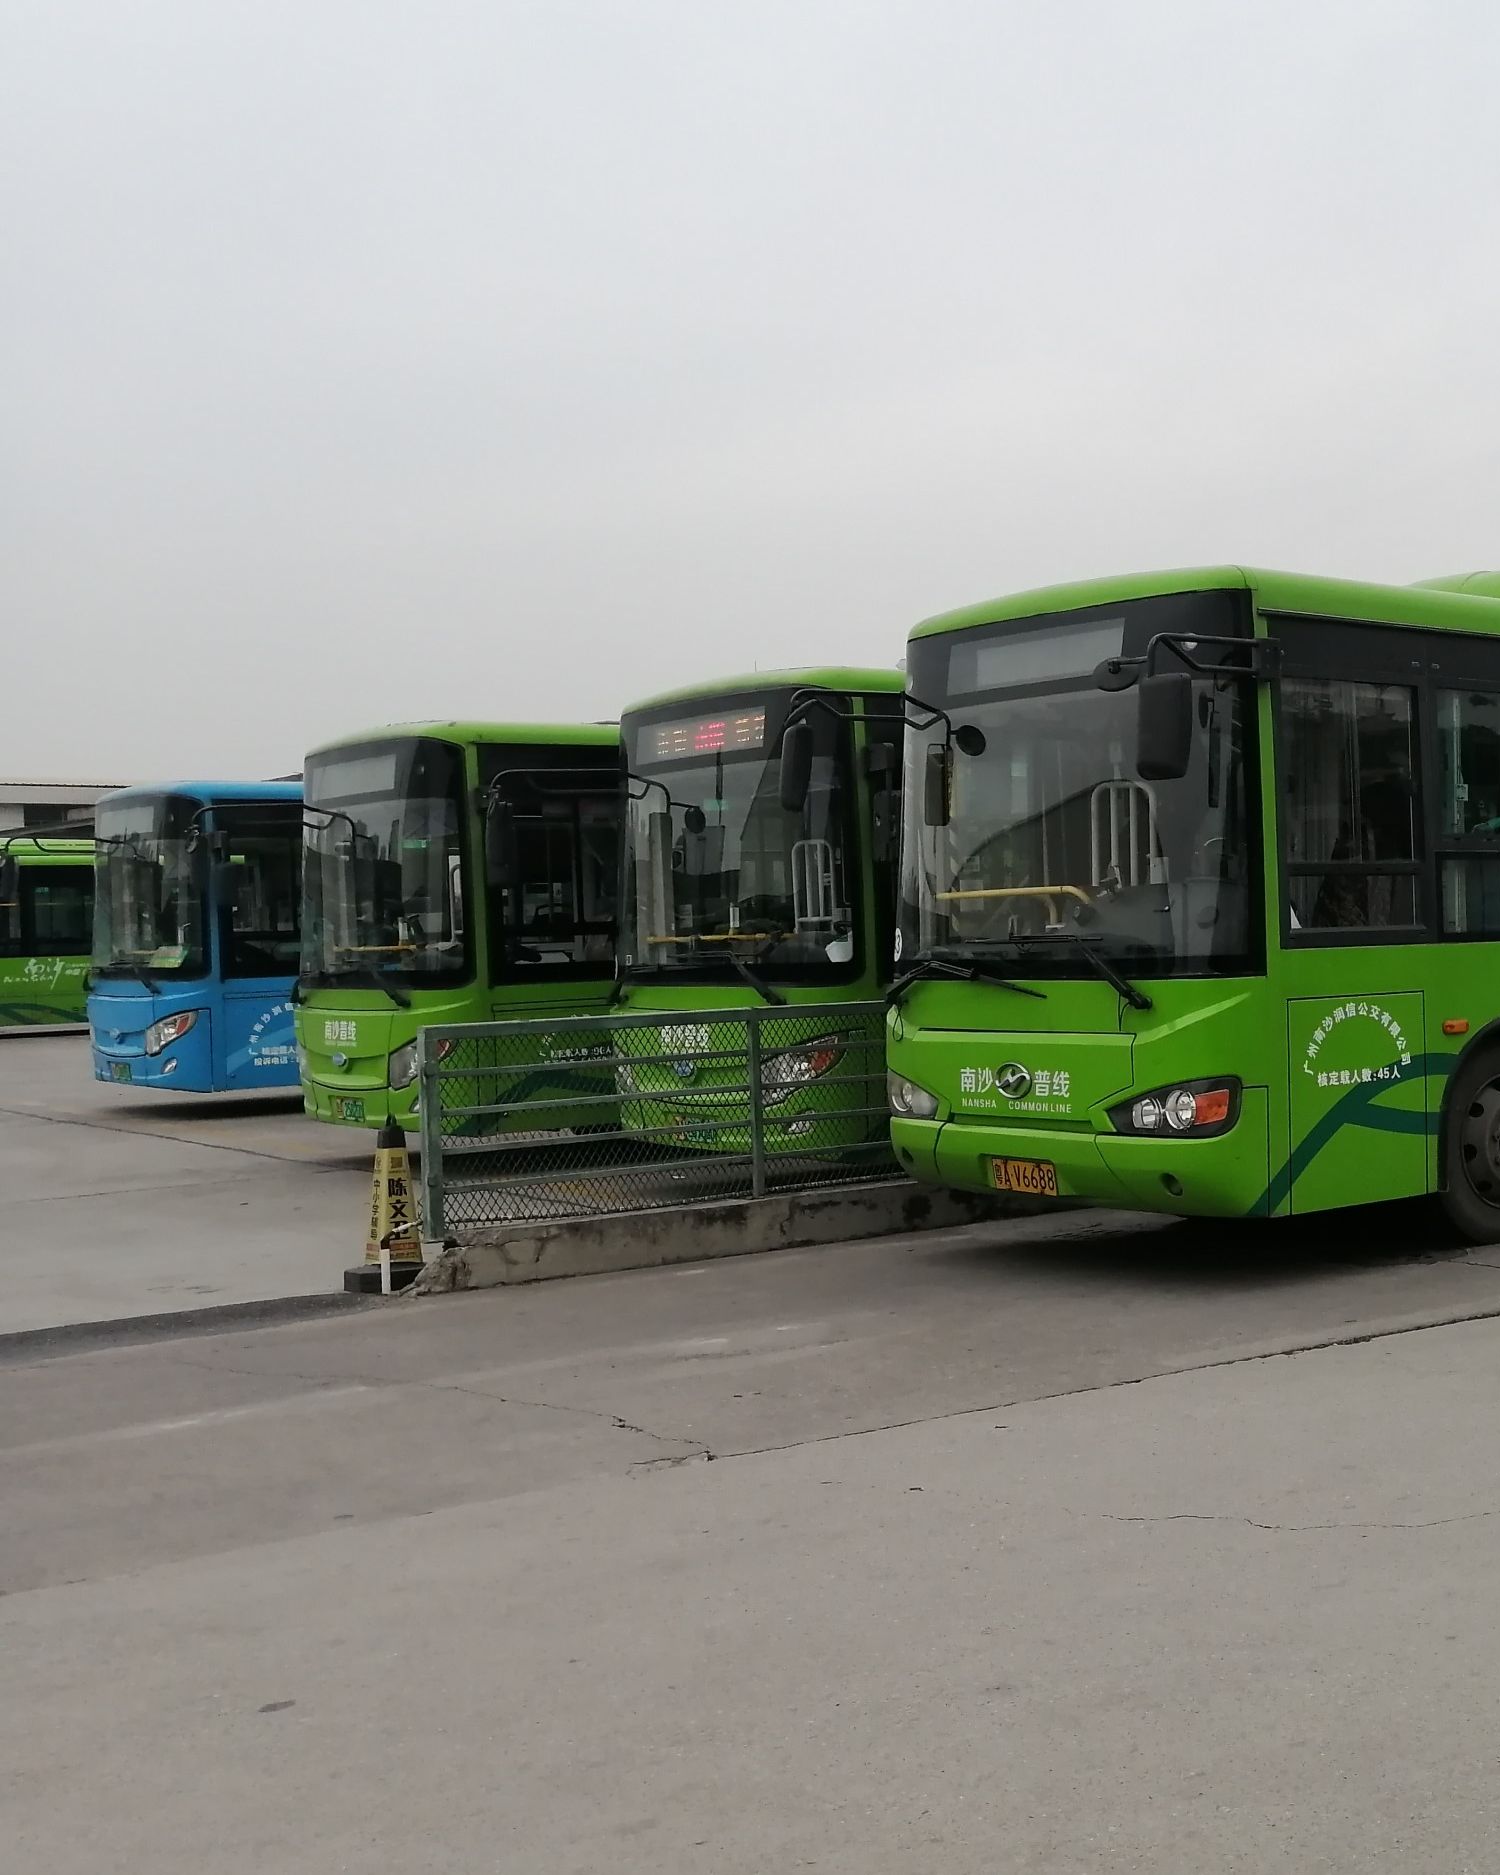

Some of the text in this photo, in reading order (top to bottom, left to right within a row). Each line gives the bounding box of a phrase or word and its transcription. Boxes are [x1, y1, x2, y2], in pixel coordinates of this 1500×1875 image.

[960, 1067, 1070, 1098] 南沙 普线
[961, 1098, 1072, 1114] NANSHA COMMON LINE
